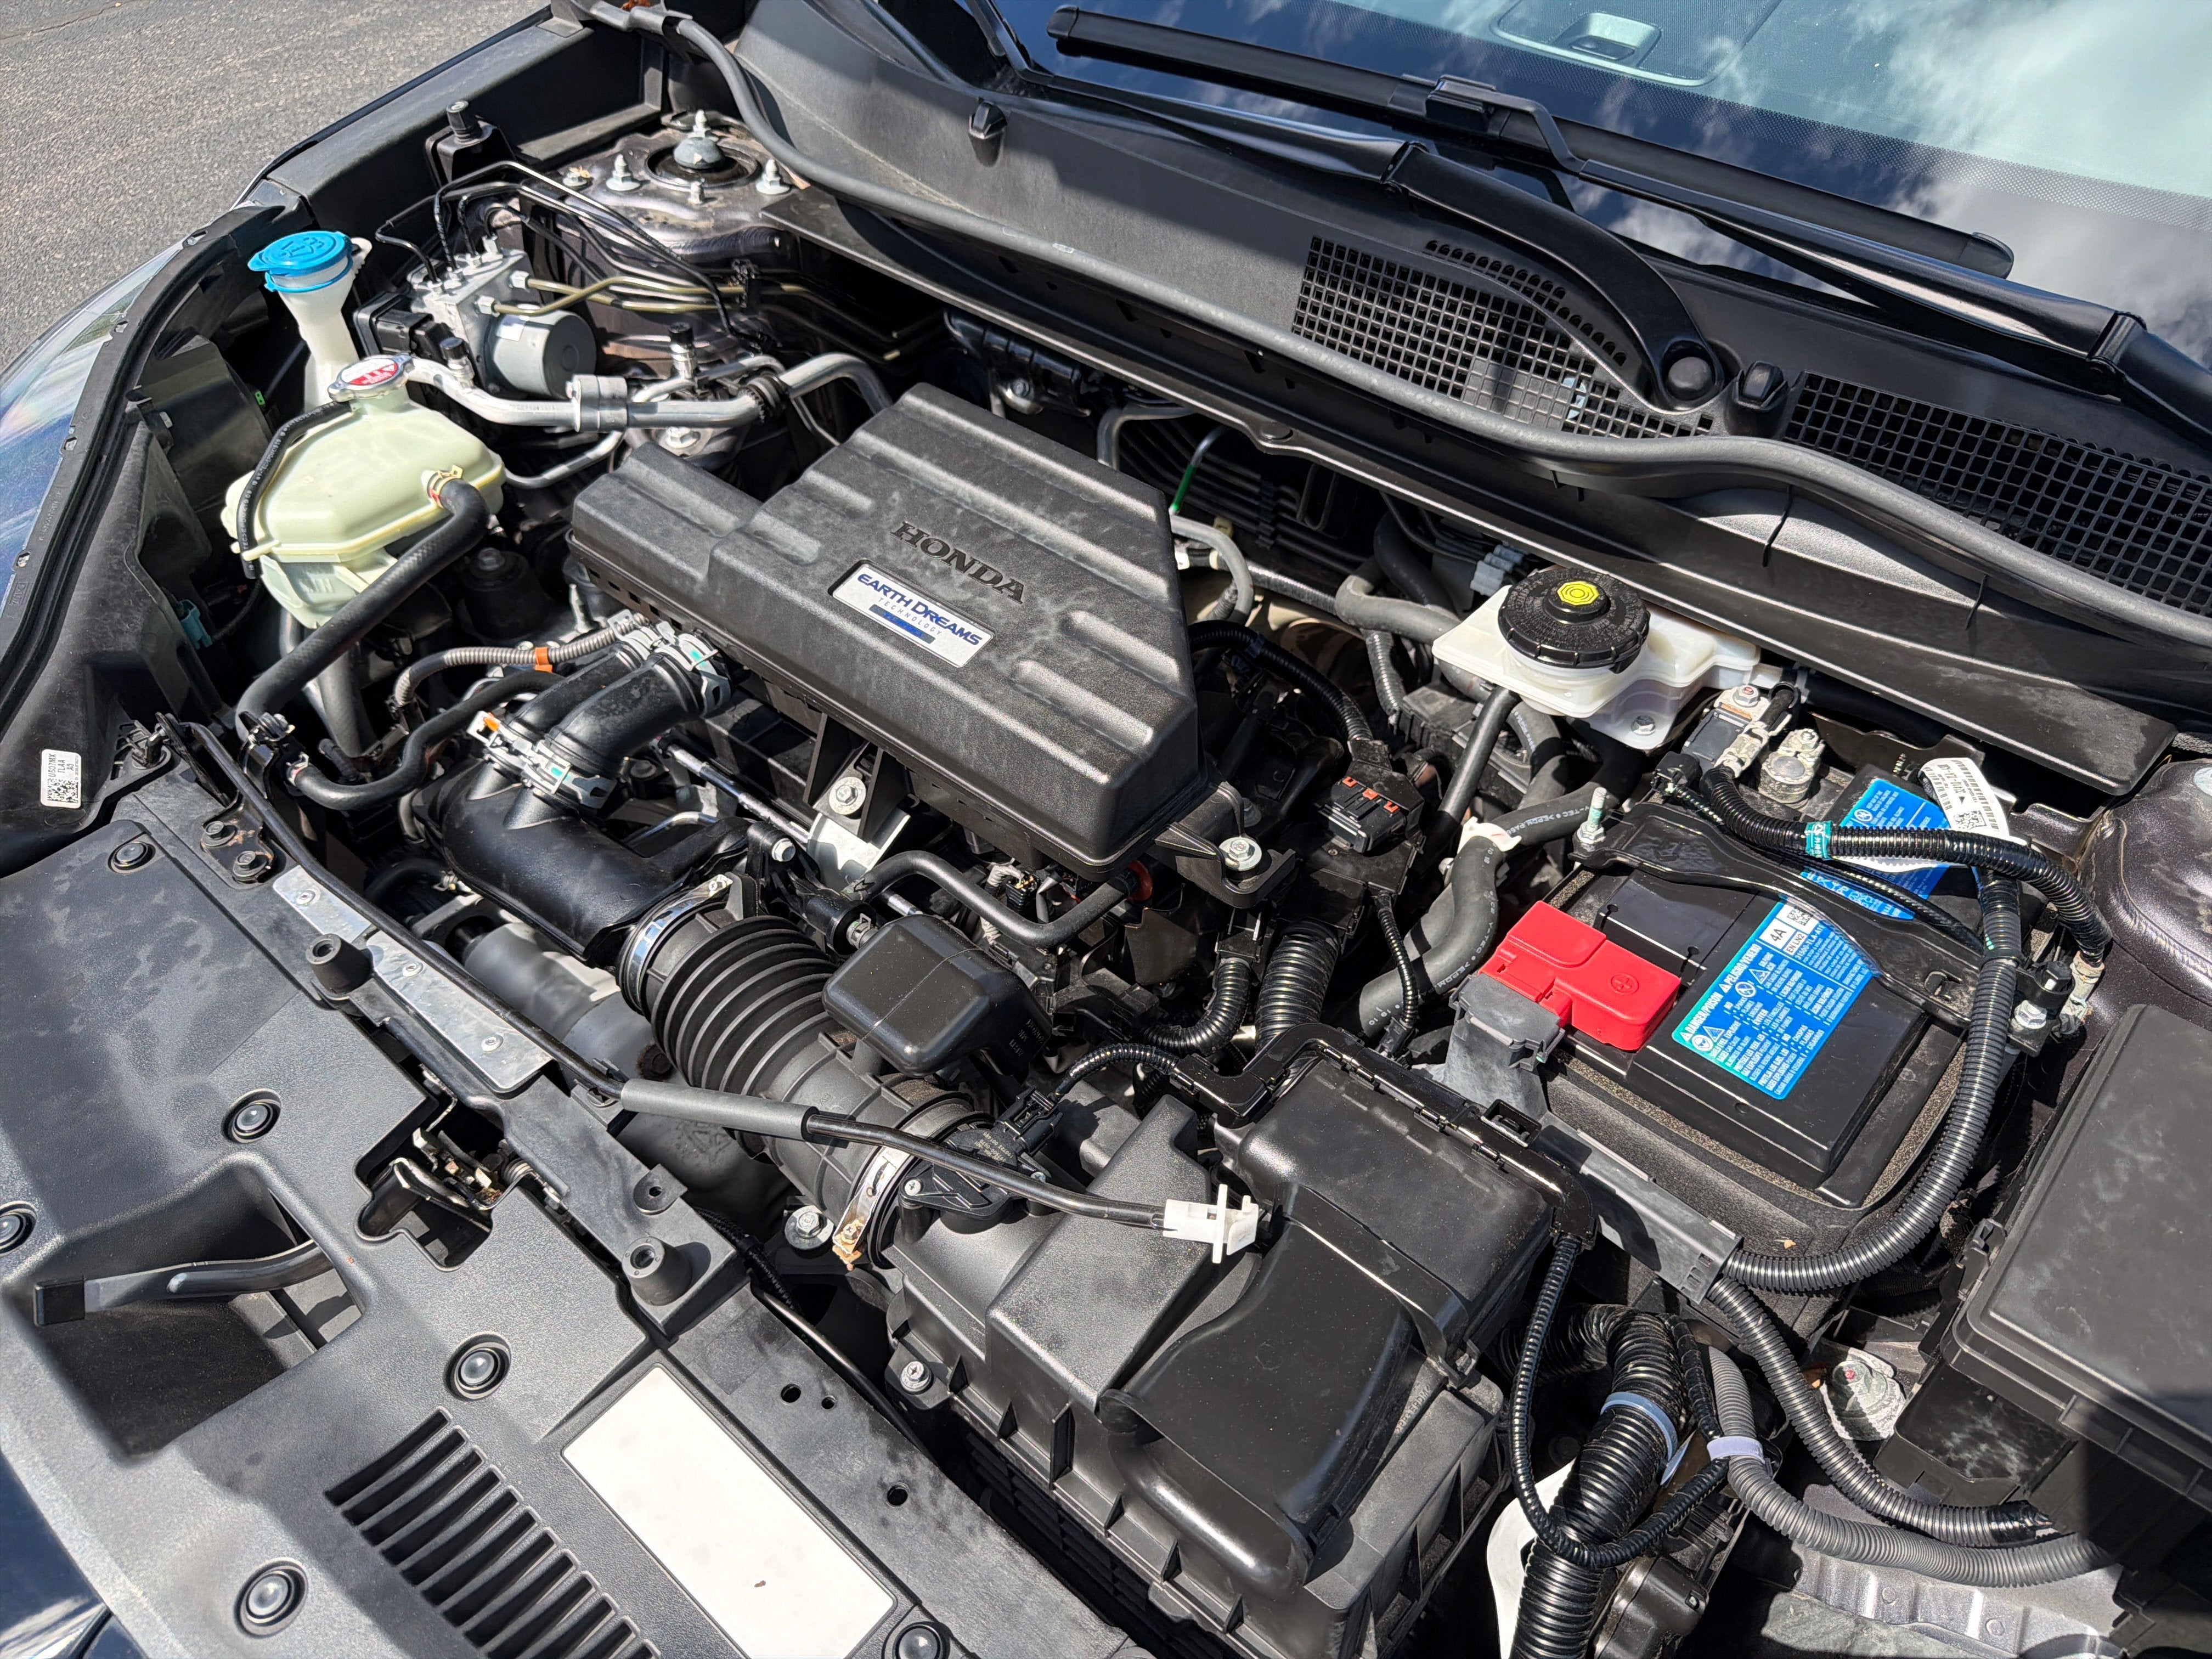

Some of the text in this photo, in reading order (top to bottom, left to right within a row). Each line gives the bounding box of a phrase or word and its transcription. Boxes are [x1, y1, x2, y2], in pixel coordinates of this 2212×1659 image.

[890, 521, 1025, 605] HONDA
[857, 573, 911, 607] EARTH
[911, 601, 983, 646] DREAMS
[878, 597, 943, 636] TECHNOLOGY
[1768, 924, 1787, 944] 4A
[1785, 943, 1797, 954] EN
[1791, 932, 1805, 946] LN2
[1683, 990, 1724, 1035] DANGER/POISON
[1722, 941, 1763, 987] PELIGRO/VENENO
